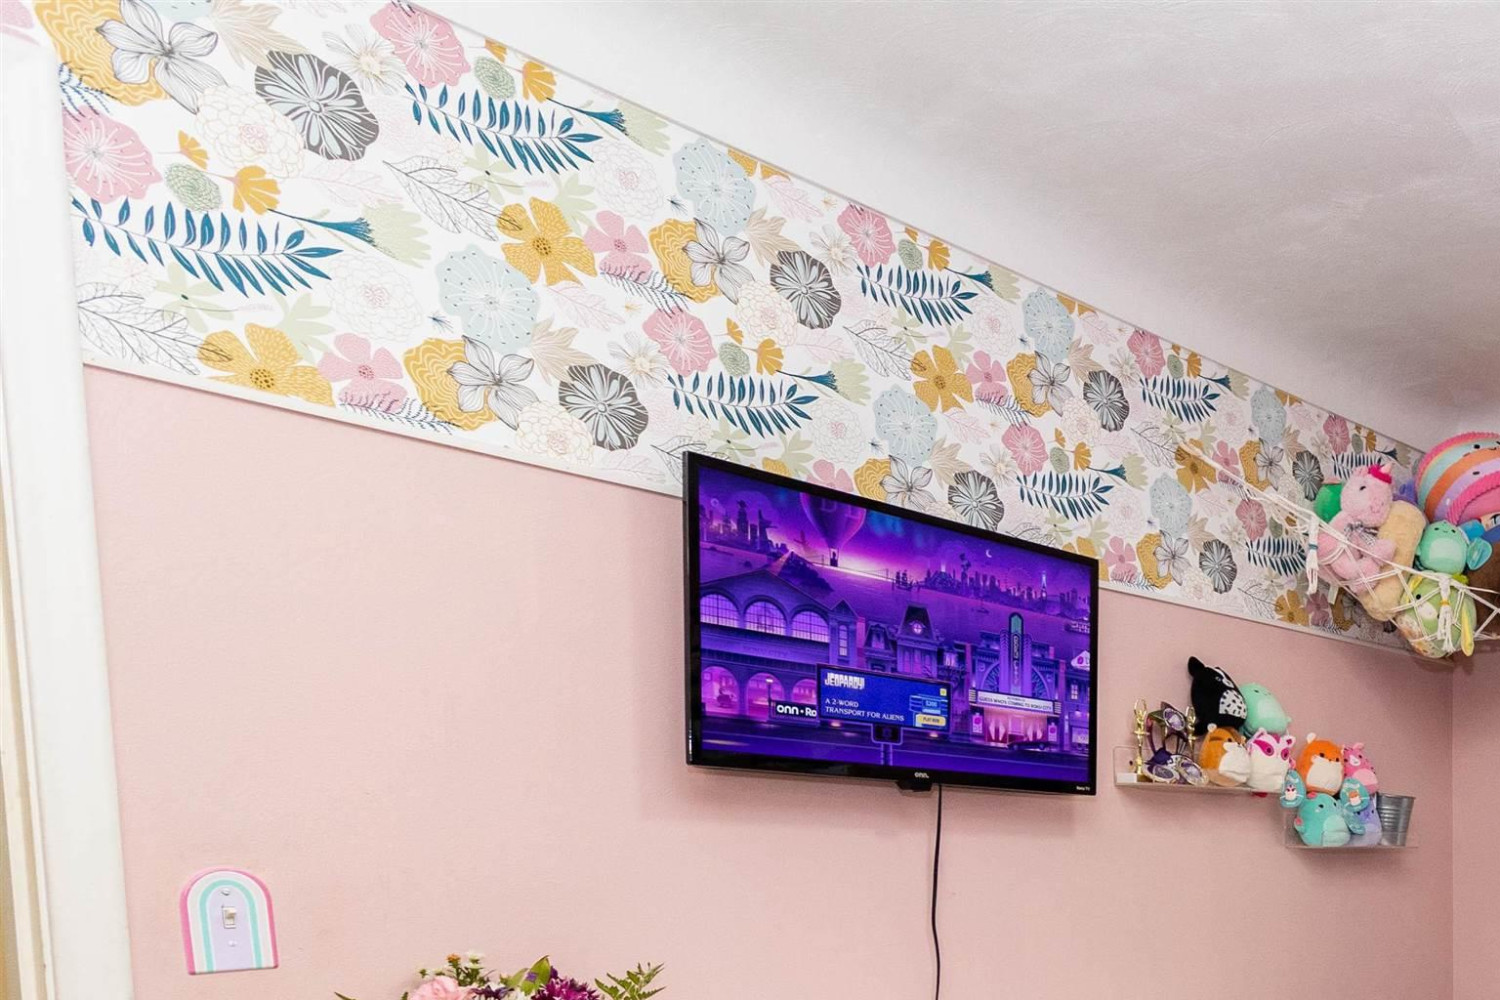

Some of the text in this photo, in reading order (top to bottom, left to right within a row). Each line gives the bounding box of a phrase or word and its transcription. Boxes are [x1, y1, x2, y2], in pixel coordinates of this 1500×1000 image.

[824, 672, 865, 690] JEOPARDY!
[776, 704, 817, 716] onn Ro
[832, 699, 859, 708] 2-WORD
[825, 706, 904, 722] TRANSPORT FOR ALIENS
